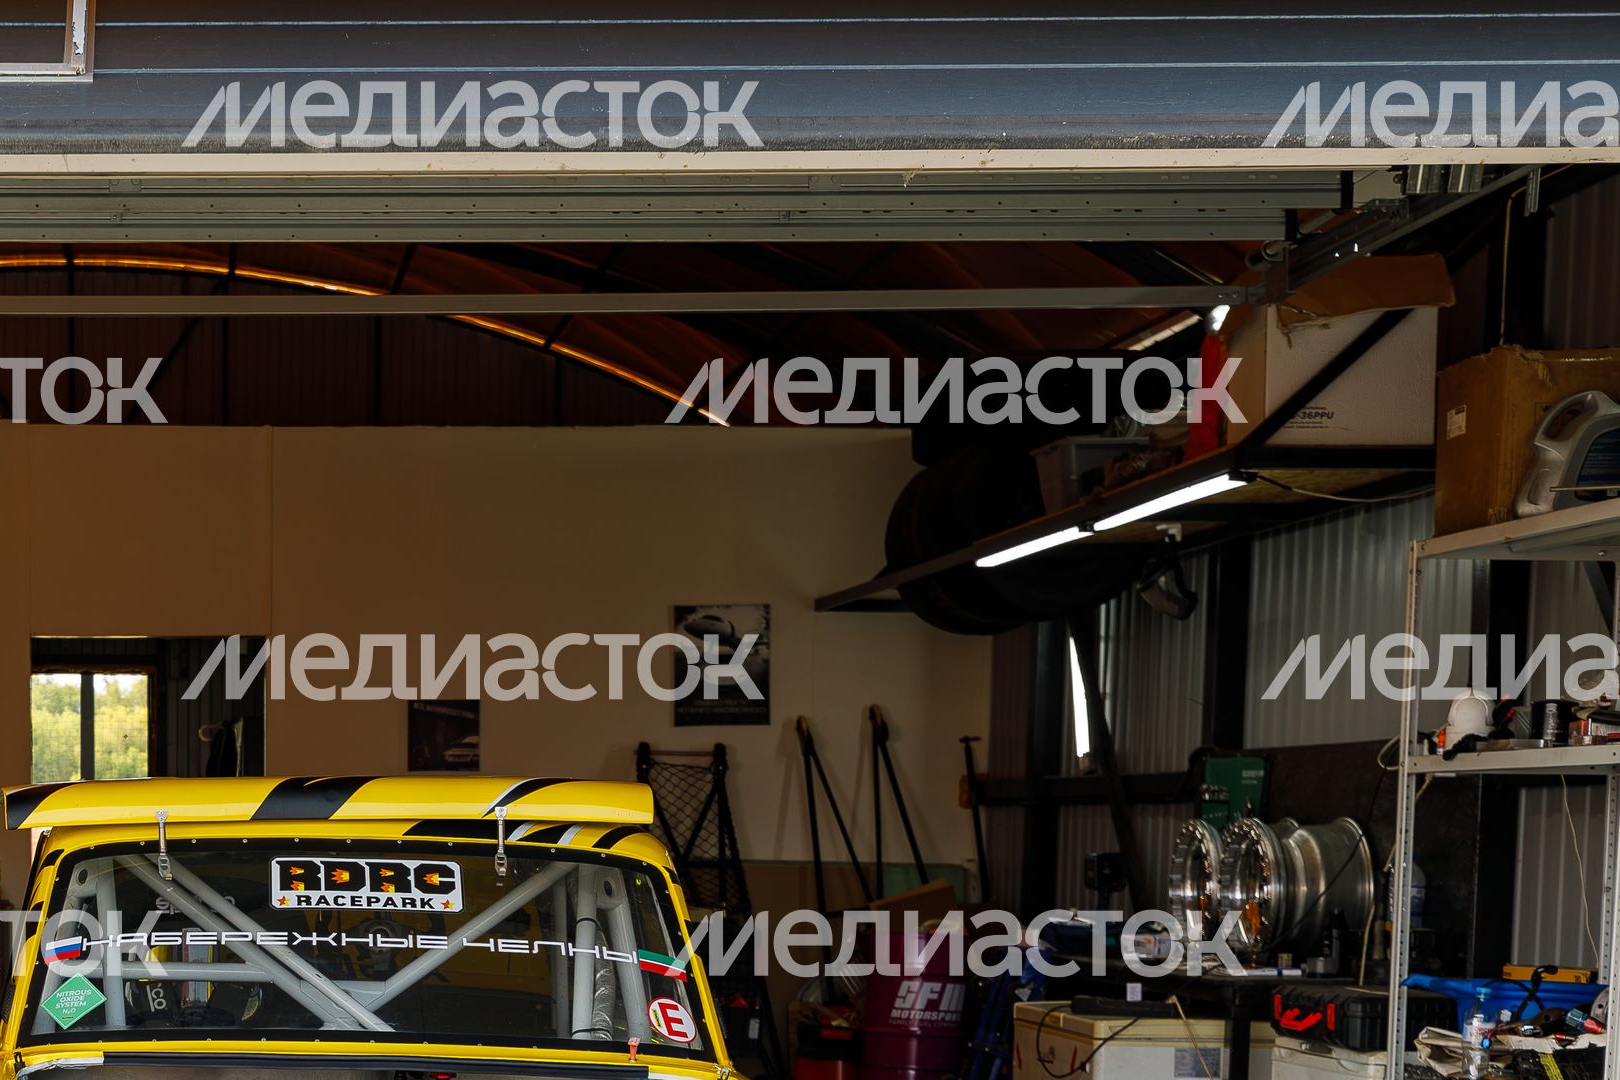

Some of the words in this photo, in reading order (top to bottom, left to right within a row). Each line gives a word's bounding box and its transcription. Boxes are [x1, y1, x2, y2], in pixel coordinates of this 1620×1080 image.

[275, 860, 456, 894] RDRC
[295, 894, 436, 909] RACEPARK
[82, 931, 448, 951] НАБЕРЕЖНЫЕ
[462, 937, 639, 964] ЧЕЛНЫ
[56, 989, 92, 998] NITROUS
[60, 995, 86, 1003] OXIDE
[55, 1001, 87, 1009] SYSTEM
[658, 1002, 689, 1039] E
